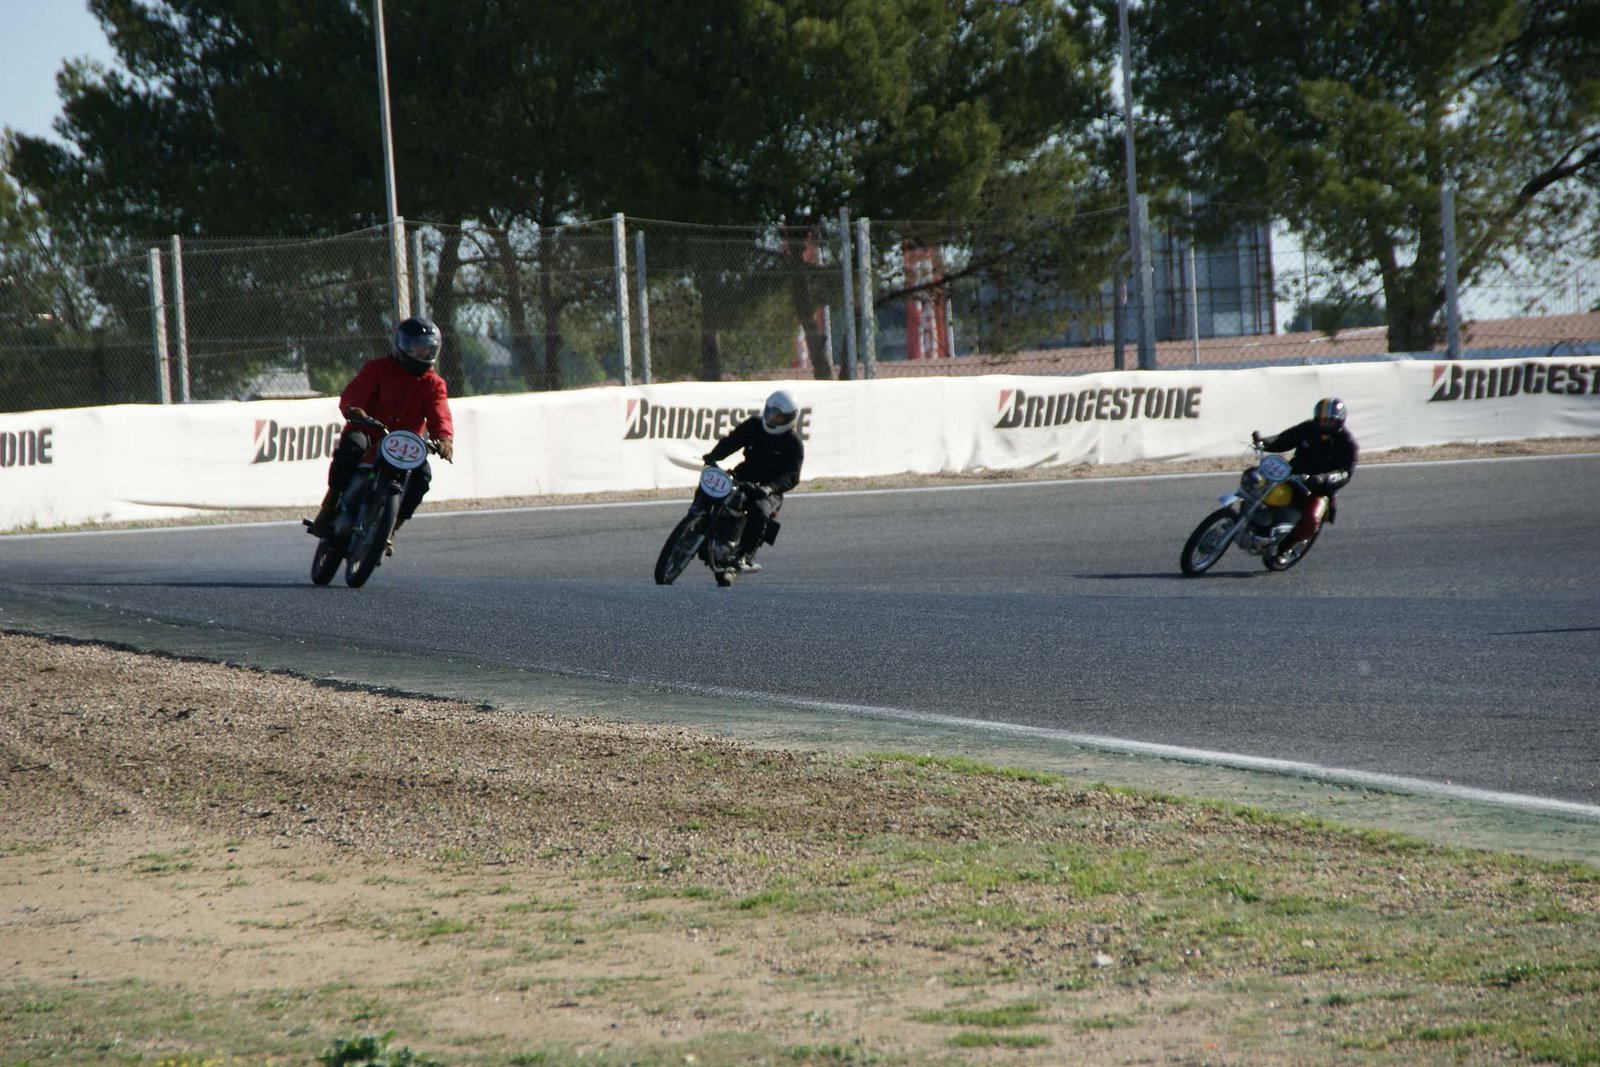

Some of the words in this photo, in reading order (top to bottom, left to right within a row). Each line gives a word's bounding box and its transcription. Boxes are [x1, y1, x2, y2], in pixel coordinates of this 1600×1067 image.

[624, 398, 812, 440] BRIDGESE
[994, 386, 1202, 428] BRIDGESTONE
[387, 438, 421, 460] 242
